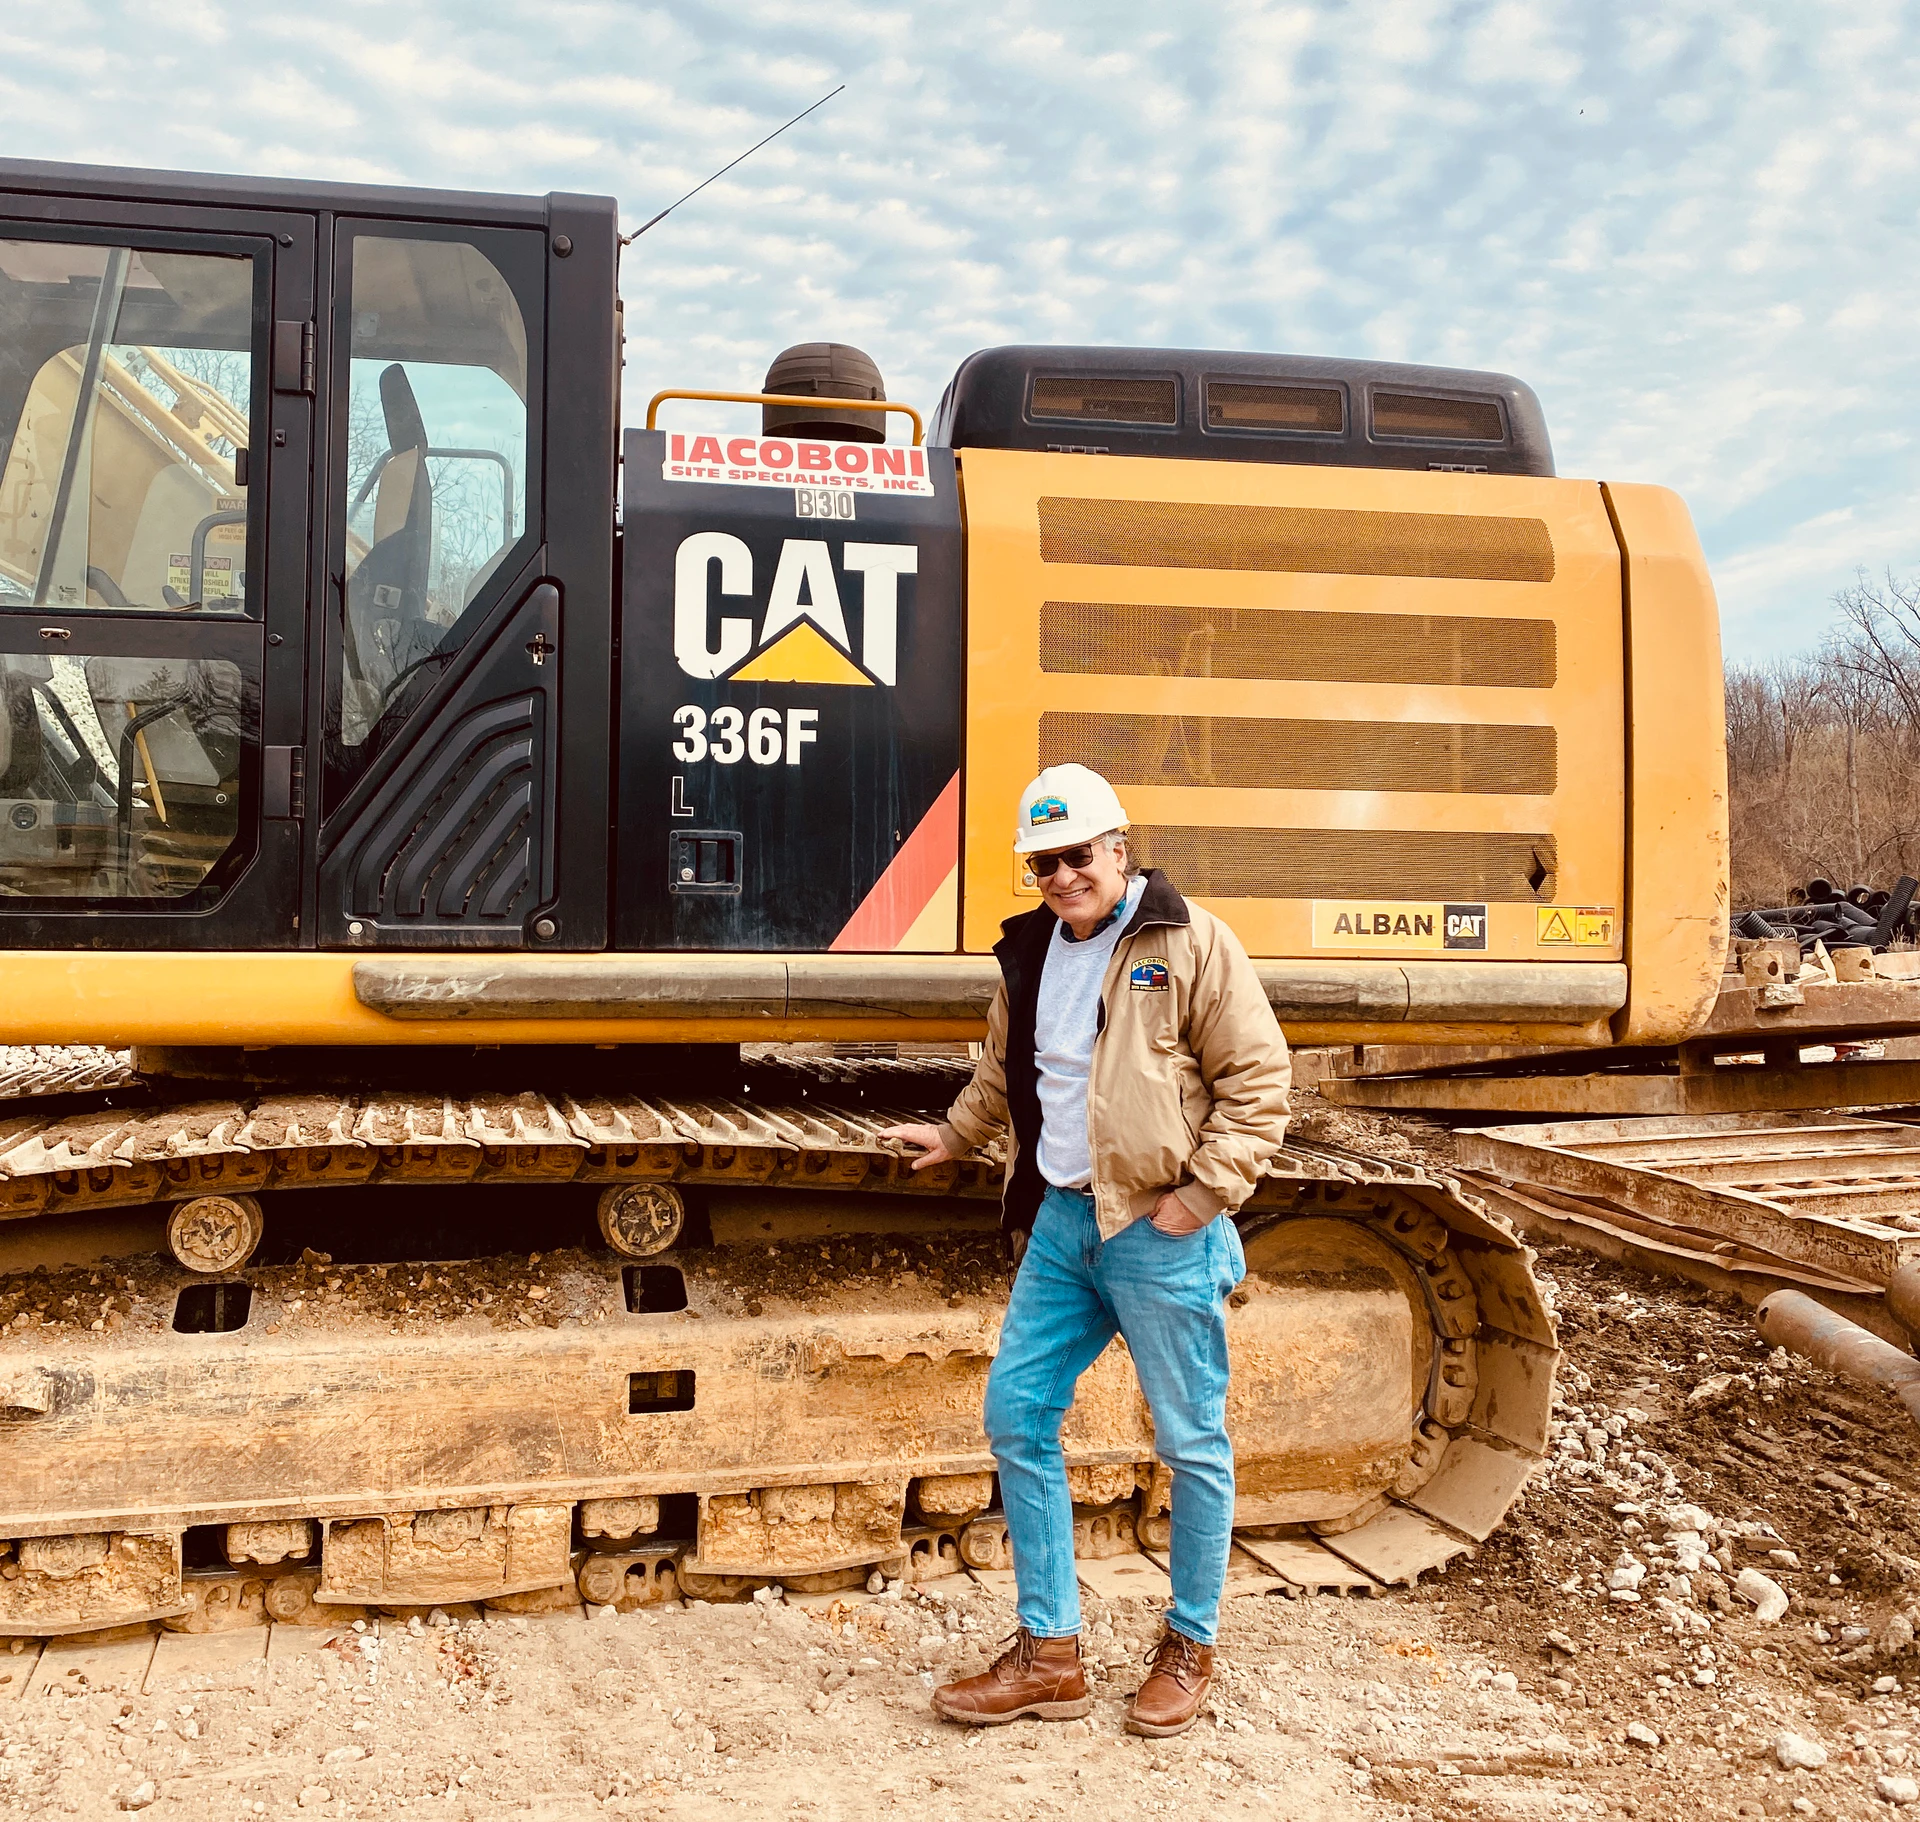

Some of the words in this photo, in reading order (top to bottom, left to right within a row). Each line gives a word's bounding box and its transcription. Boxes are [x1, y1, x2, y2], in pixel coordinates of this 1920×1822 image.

[671, 434, 925, 477] IACOBONI
[671, 466, 720, 479] SITE
[728, 469, 875, 490] SPECIALISTS,
[883, 479, 926, 491] INC.
[219, 500, 245, 510] WAR
[798, 492, 853, 519] B30
[171, 555, 230, 569] CAION
[204, 579, 229, 587] DSHIELD
[674, 531, 918, 687] CAT
[672, 704, 819, 765] 336F
[671, 776, 694, 817] L
[1333, 913, 1434, 937] ALBAN
[1447, 913, 1485, 938] CAT
